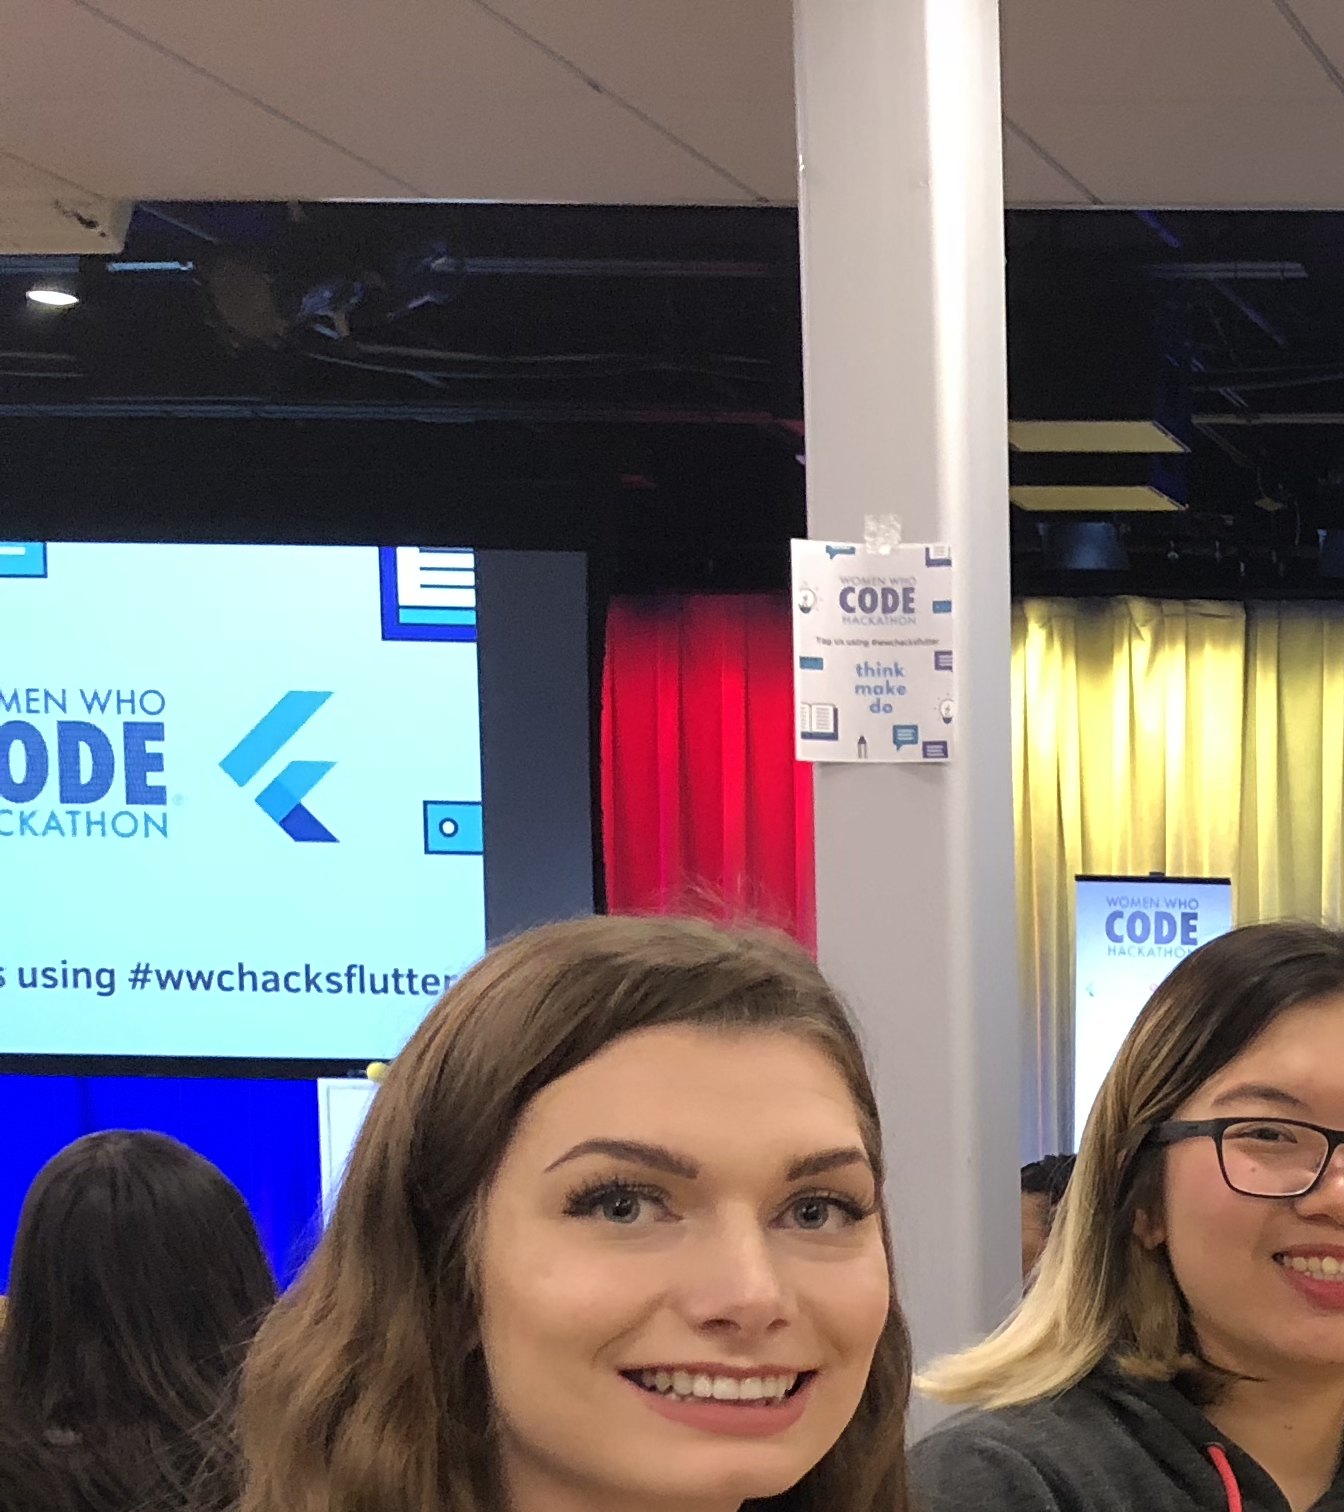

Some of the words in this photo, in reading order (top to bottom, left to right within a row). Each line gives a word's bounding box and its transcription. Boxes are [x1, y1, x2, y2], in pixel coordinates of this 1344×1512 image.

[839, 575, 886, 586] WOMEN
[889, 576, 918, 586] WHO
[839, 586, 916, 614] CODE
[842, 615, 917, 626] HACKATHON
[856, 661, 905, 678] think
[854, 679, 907, 696] make
[80, 688, 166, 715] WHO
[869, 698, 893, 714] do
[1106, 896, 1160, 909] WOMEN
[1164, 897, 1199, 910] WHO
[1105, 910, 1198, 946] CODE
[18, 959, 116, 997] using
[128, 961, 459, 997] #wwchacksflutter
